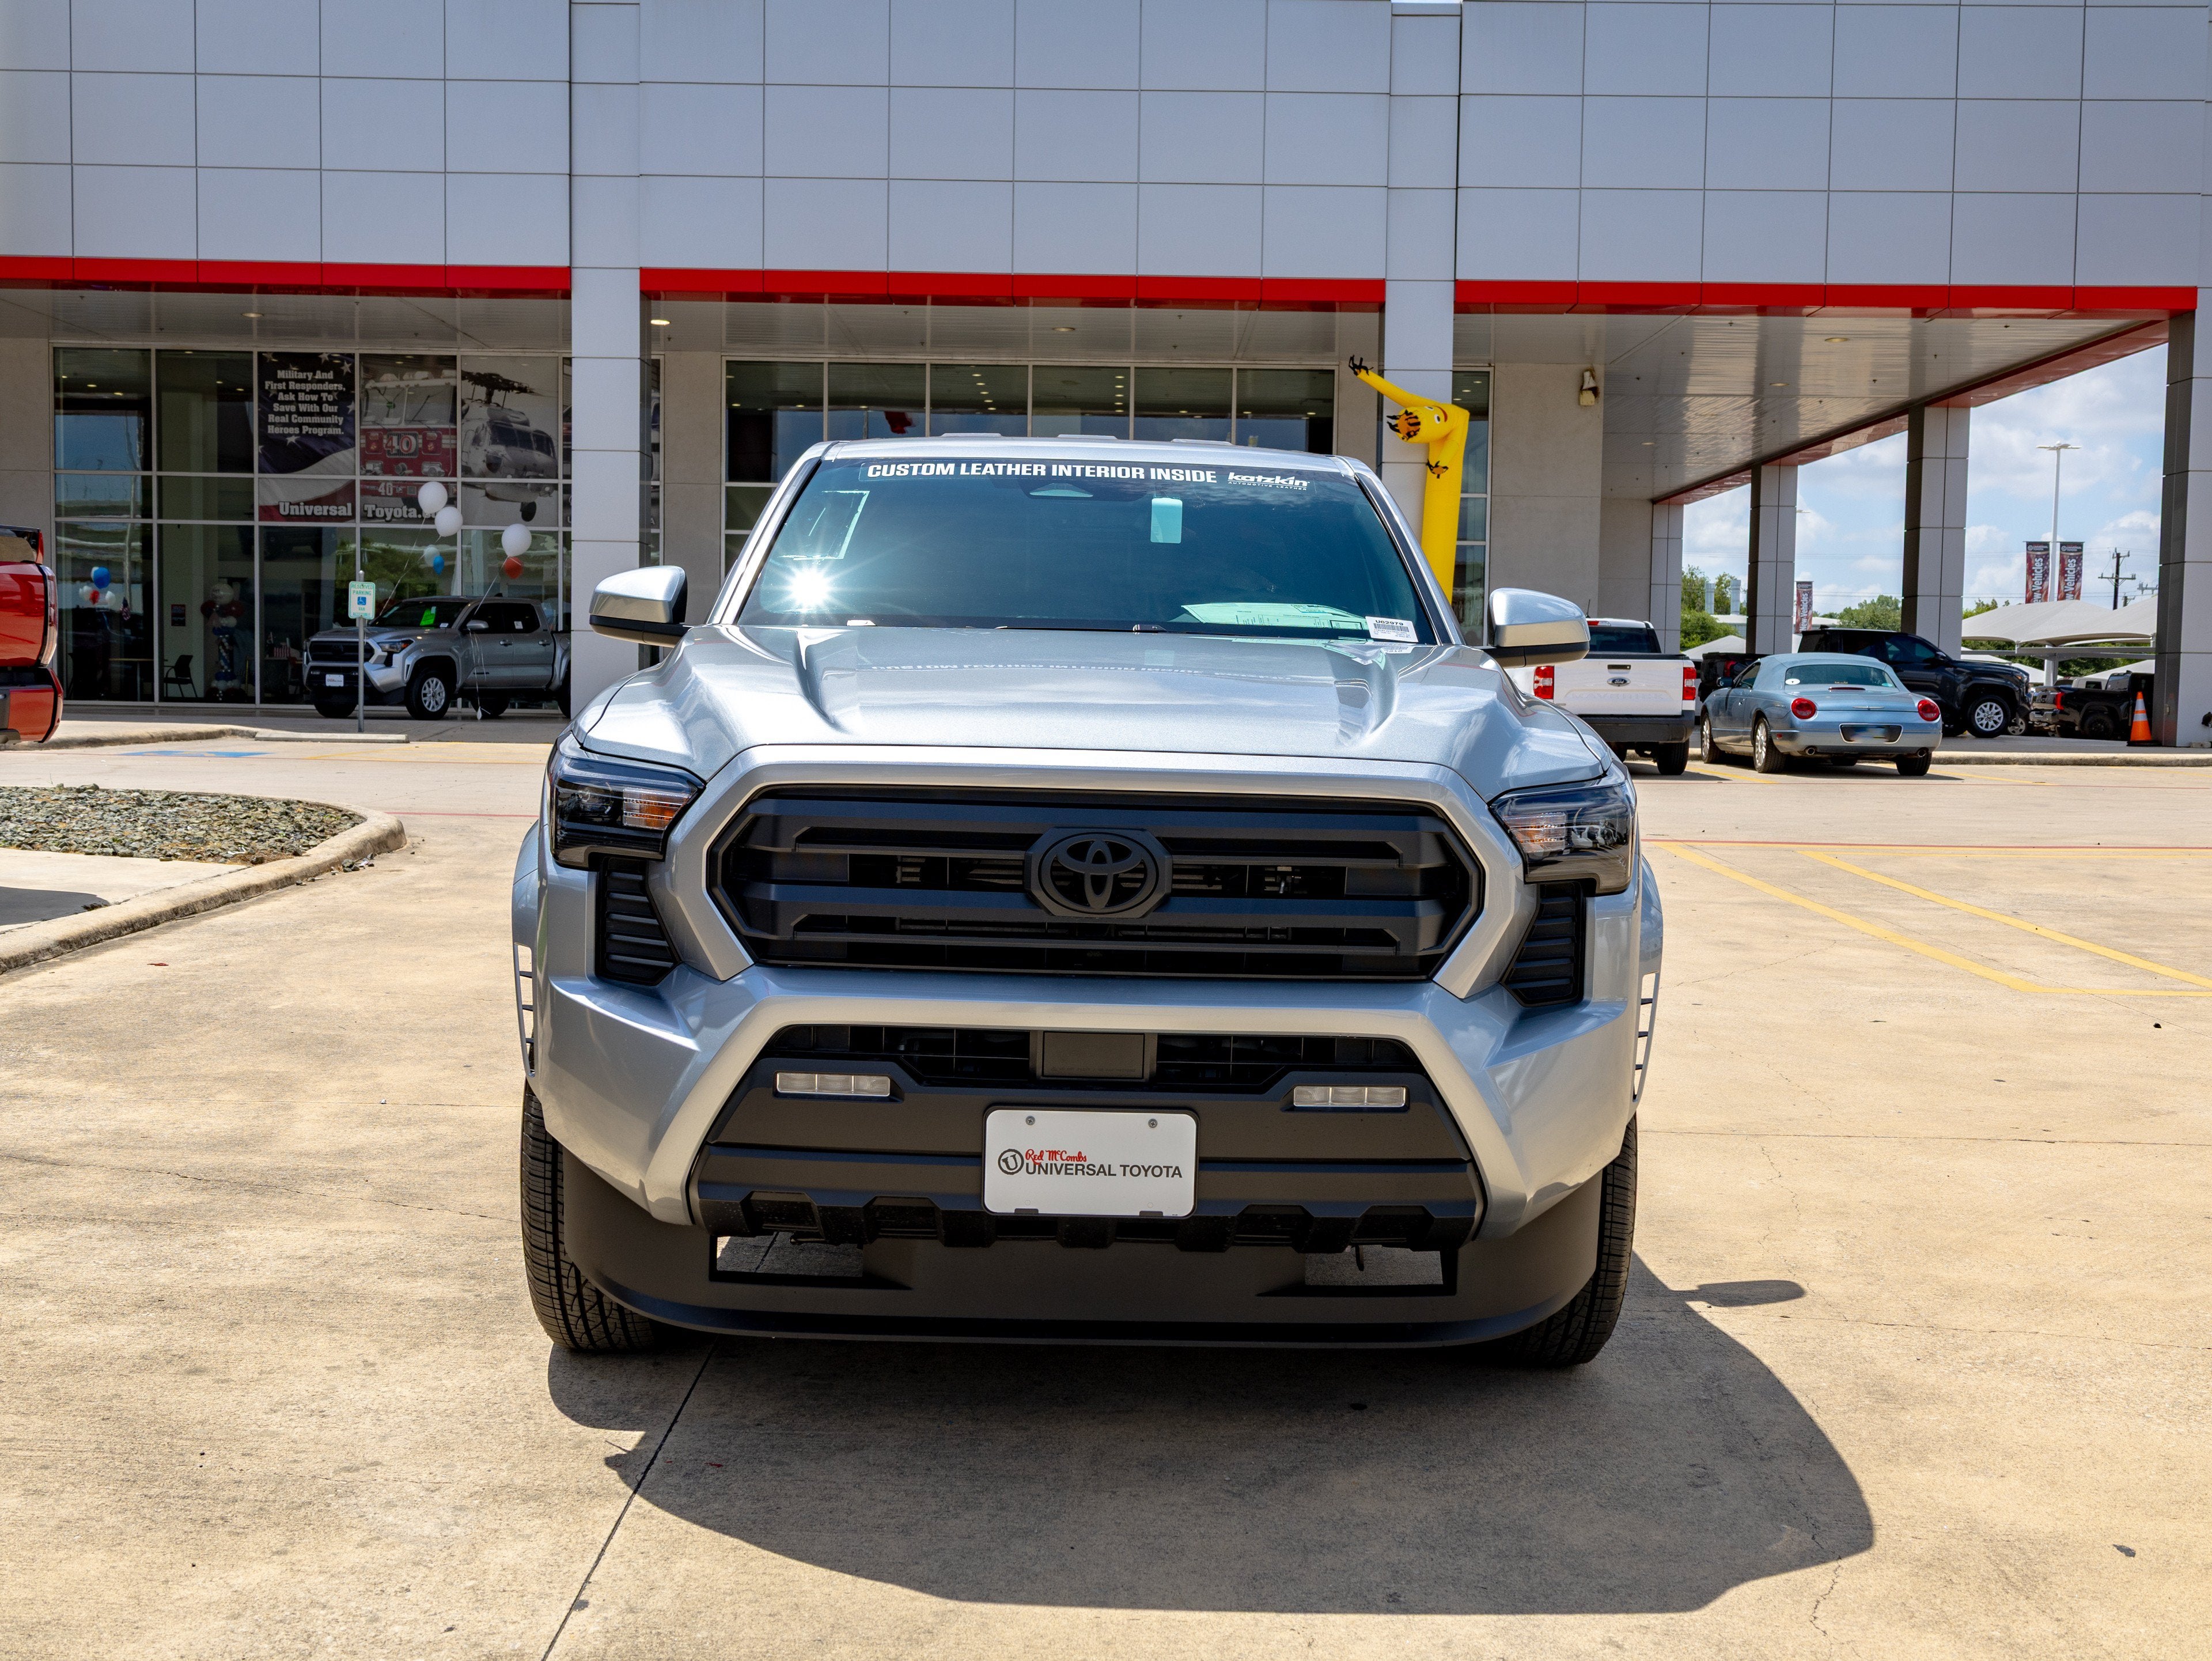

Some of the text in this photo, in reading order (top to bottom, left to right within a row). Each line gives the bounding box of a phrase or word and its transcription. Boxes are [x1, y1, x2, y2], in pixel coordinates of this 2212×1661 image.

[277, 370, 334, 380] Military And
[265, 381, 346, 392] First Responders,
[278, 392, 334, 401] Ask How To
[273, 403, 338, 413] Save With Our
[268, 414, 344, 425] Real Community
[267, 425, 344, 436] Heroes Program.
[384, 435, 416, 454] 40
[867, 463, 1217, 483] CUSTOM LEATHER INTERIOR INSIDE
[279, 502, 352, 516] Universal
[2032, 558, 2043, 591] Vehicles
[2064, 558, 2076, 592] Vehicles
[1800, 593, 1808, 618] Vehicles
[1025, 1149, 1087, 1165] Red McCombs
[1025, 1163, 1183, 1178] UNIVERSAL TOYOTA
